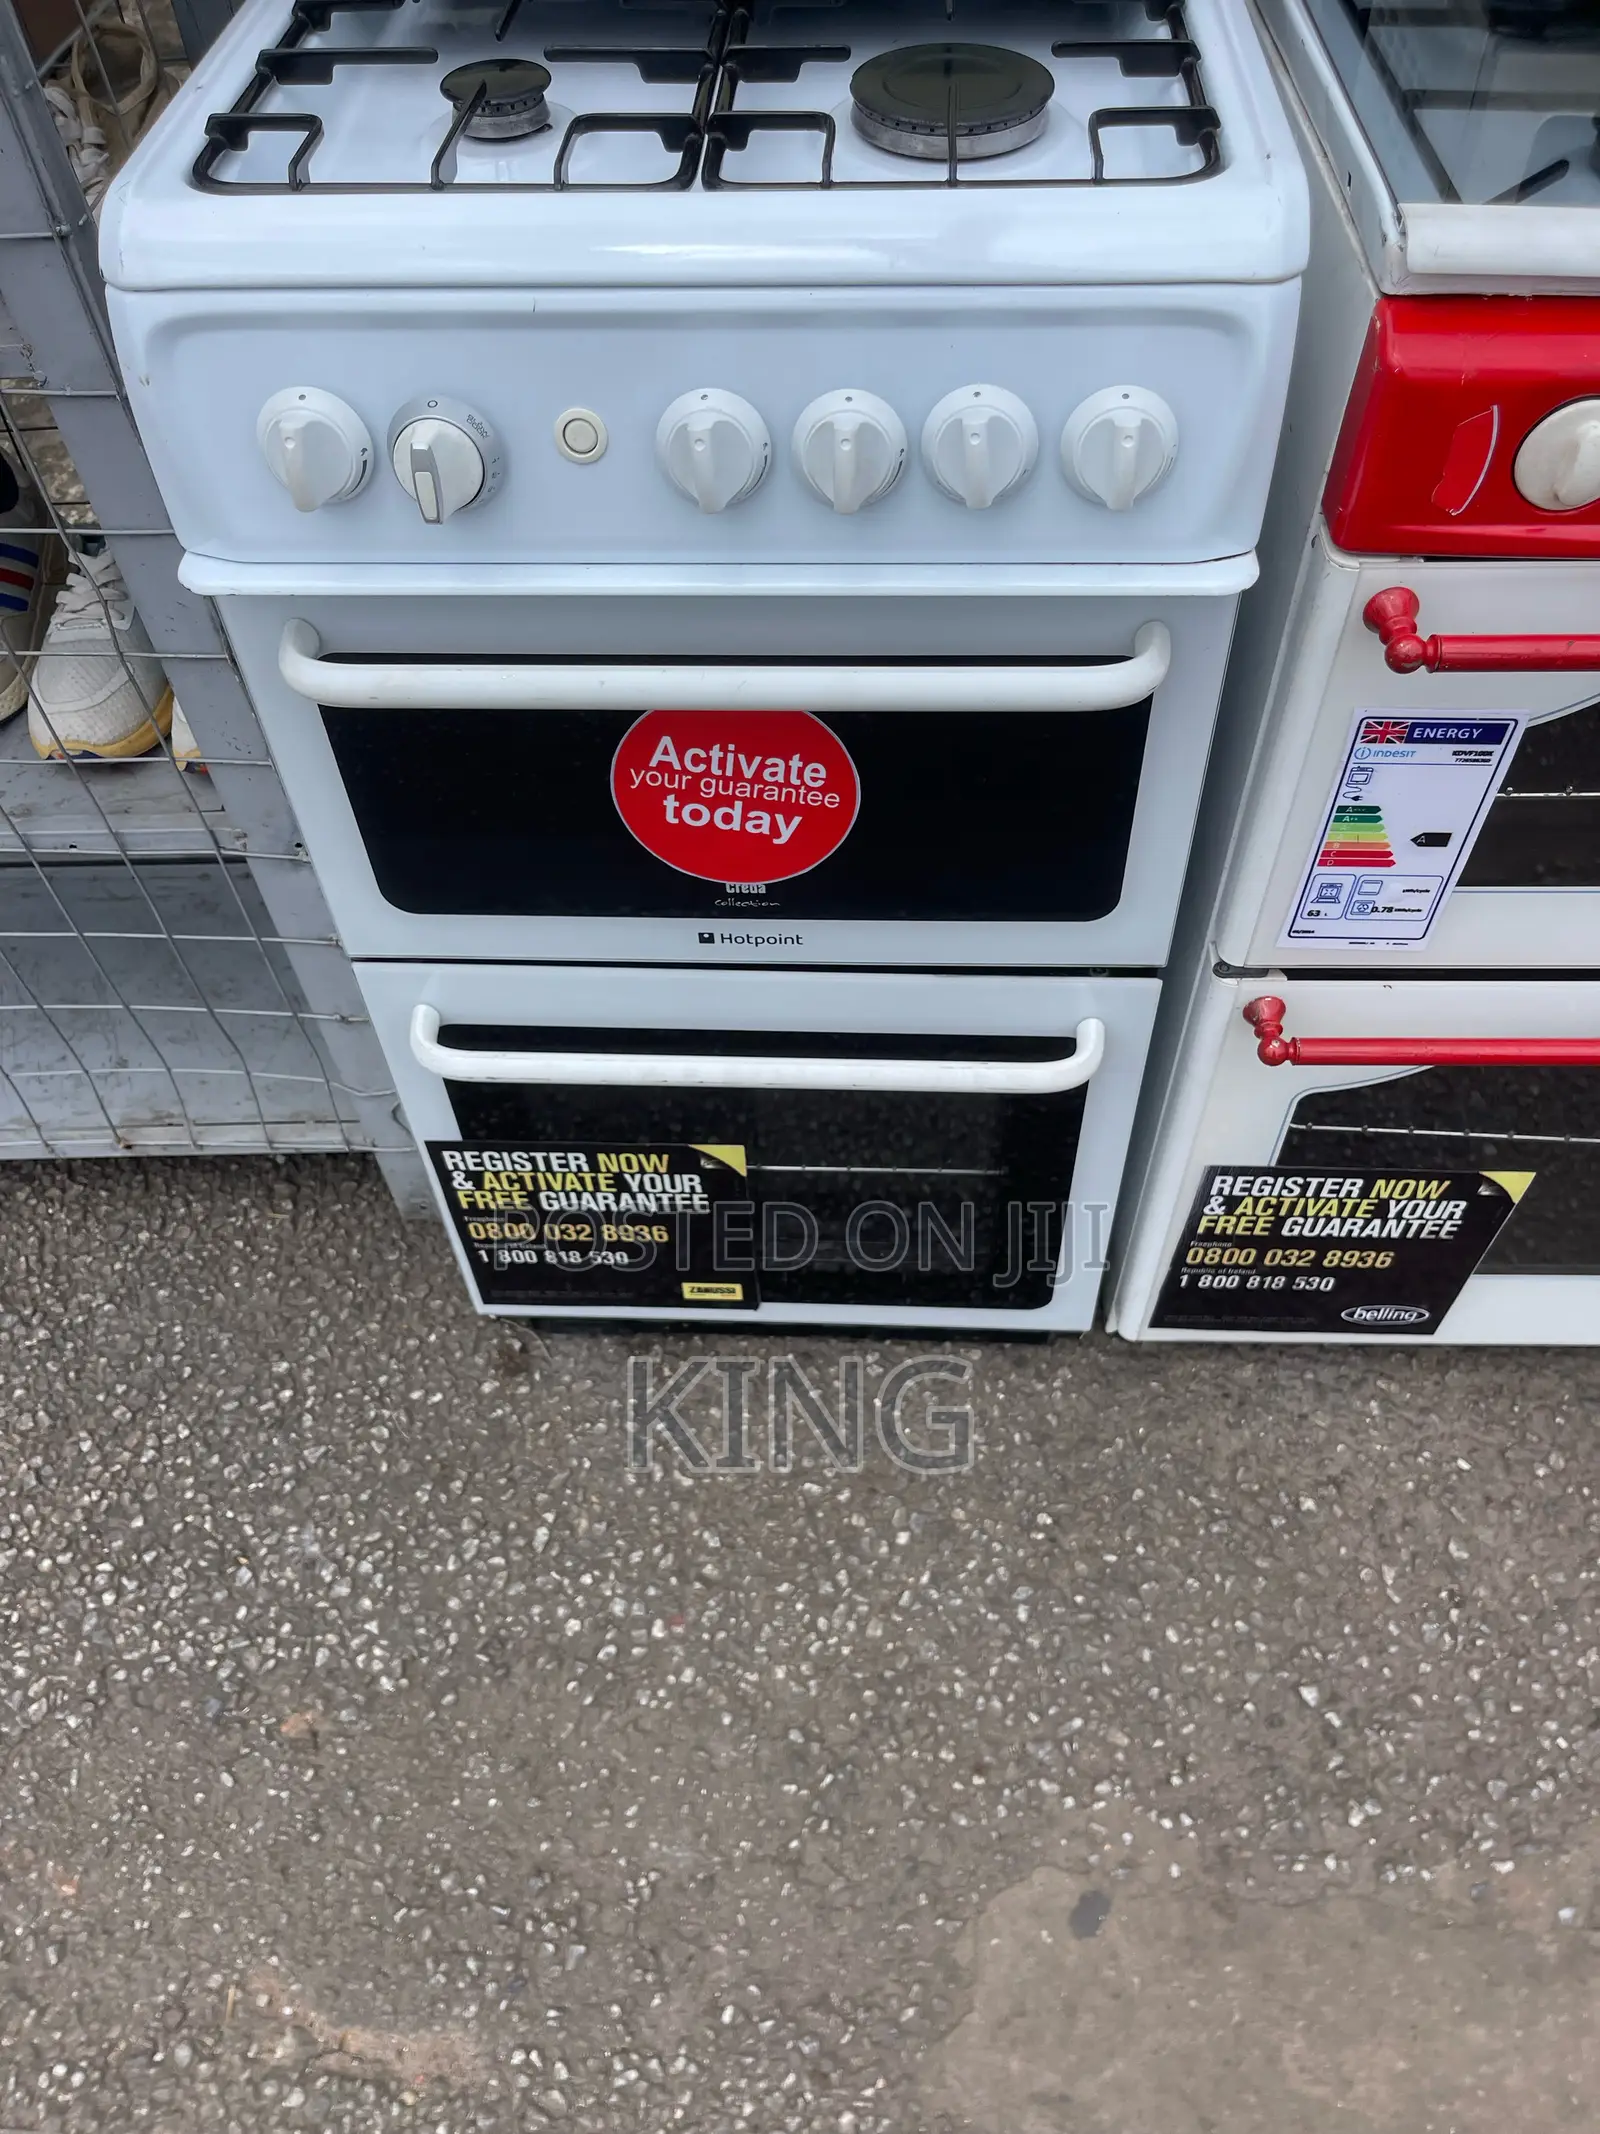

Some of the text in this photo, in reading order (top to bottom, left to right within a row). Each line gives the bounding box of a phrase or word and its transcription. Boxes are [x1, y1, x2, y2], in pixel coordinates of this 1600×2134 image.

[1412, 727, 1483, 739] ENERGY
[649, 735, 827, 788] Activate
[629, 767, 840, 809] your guarantee
[663, 793, 803, 845] today
[1416, 835, 1426, 844] A
[1371, 906, 1394, 914] 0.78
[720, 933, 804, 947] Hotpoint
[442, 1150, 669, 1173] REGISTER NOW
[452, 1171, 702, 1193] & ACTIVATE YOUR
[1210, 1175, 1451, 1200] REGISTER NOW
[457, 1191, 711, 1213] FREE GUARANTEE
[1203, 1196, 1468, 1219] & ACTIVATE YOUR
[468, 1222, 669, 1243] 0800 032 8936
[1197, 1215, 1463, 1240] FREE GUARANTEE
[478, 1249, 629, 1265] 1 800 818 530
[1186, 1247, 1395, 1269] 0800 032 8936
[1179, 1274, 1336, 1292] 1 800 818 530
[1353, 1308, 1417, 1323] belling
